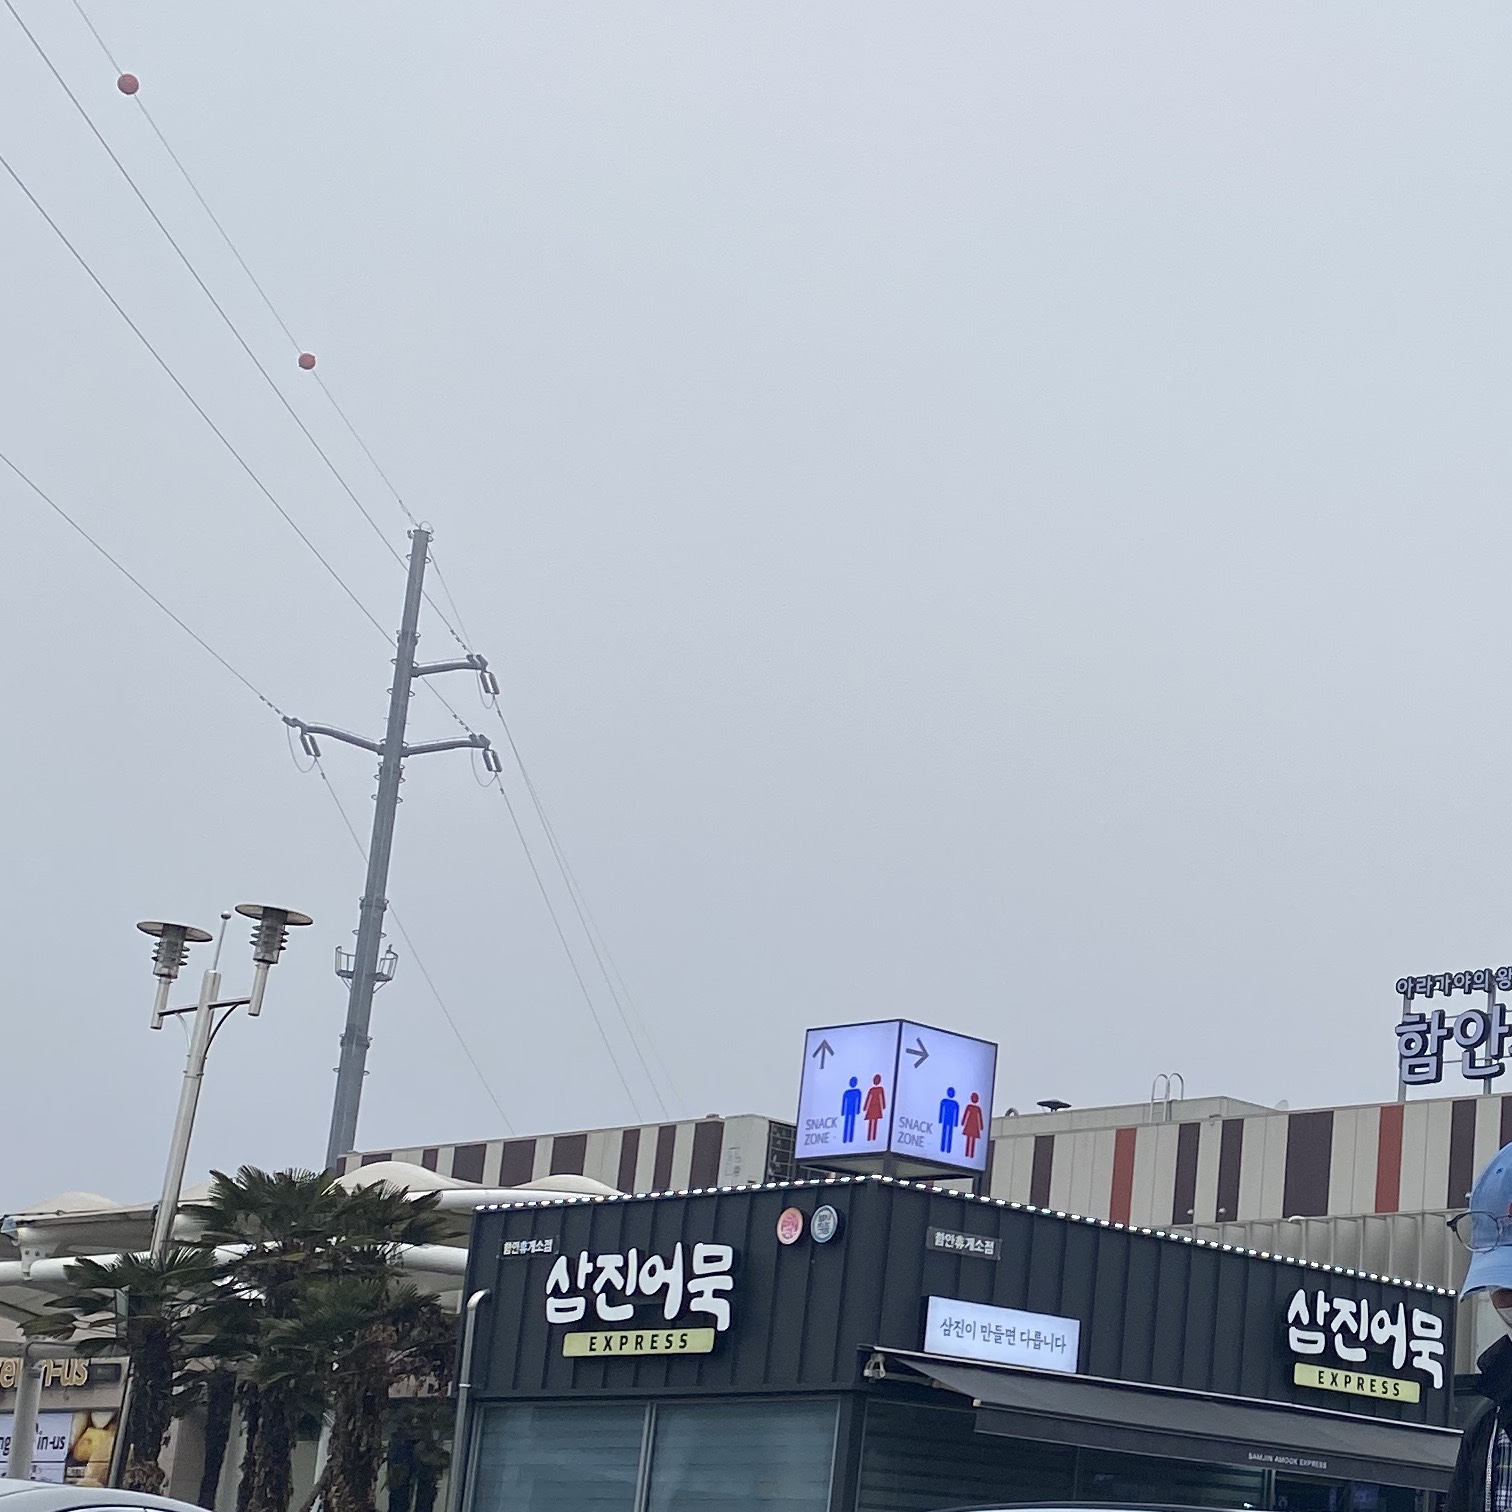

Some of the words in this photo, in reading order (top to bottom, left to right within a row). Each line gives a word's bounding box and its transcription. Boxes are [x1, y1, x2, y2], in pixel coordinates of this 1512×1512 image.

[1396, 967, 1492, 999] 아라가야의
[804, 1116, 838, 1131] SNACK
[899, 1116, 934, 1134] SNACK
[803, 1131, 830, 1146] ZONE
[897, 1131, 925, 1148] ZONE
[503, 1238, 553, 1256] 함안휴게소점
[934, 1231, 995, 1255] 함안휴게소점
[545, 1241, 734, 1331] 삼진어묵
[588, 1333, 688, 1352] EXPRESS
[939, 1316, 977, 1340] 삼진이
[980, 1323, 1017, 1346] 만들면
[1019, 1330, 1066, 1354] 다릅니다
[1287, 1288, 1445, 1389] 삼진어묵
[1317, 1370, 1401, 1397] EXPRESS
[1274, 1454, 1298, 1465] AMOOK
[1299, 1458, 1327, 1469] EXPRESS
